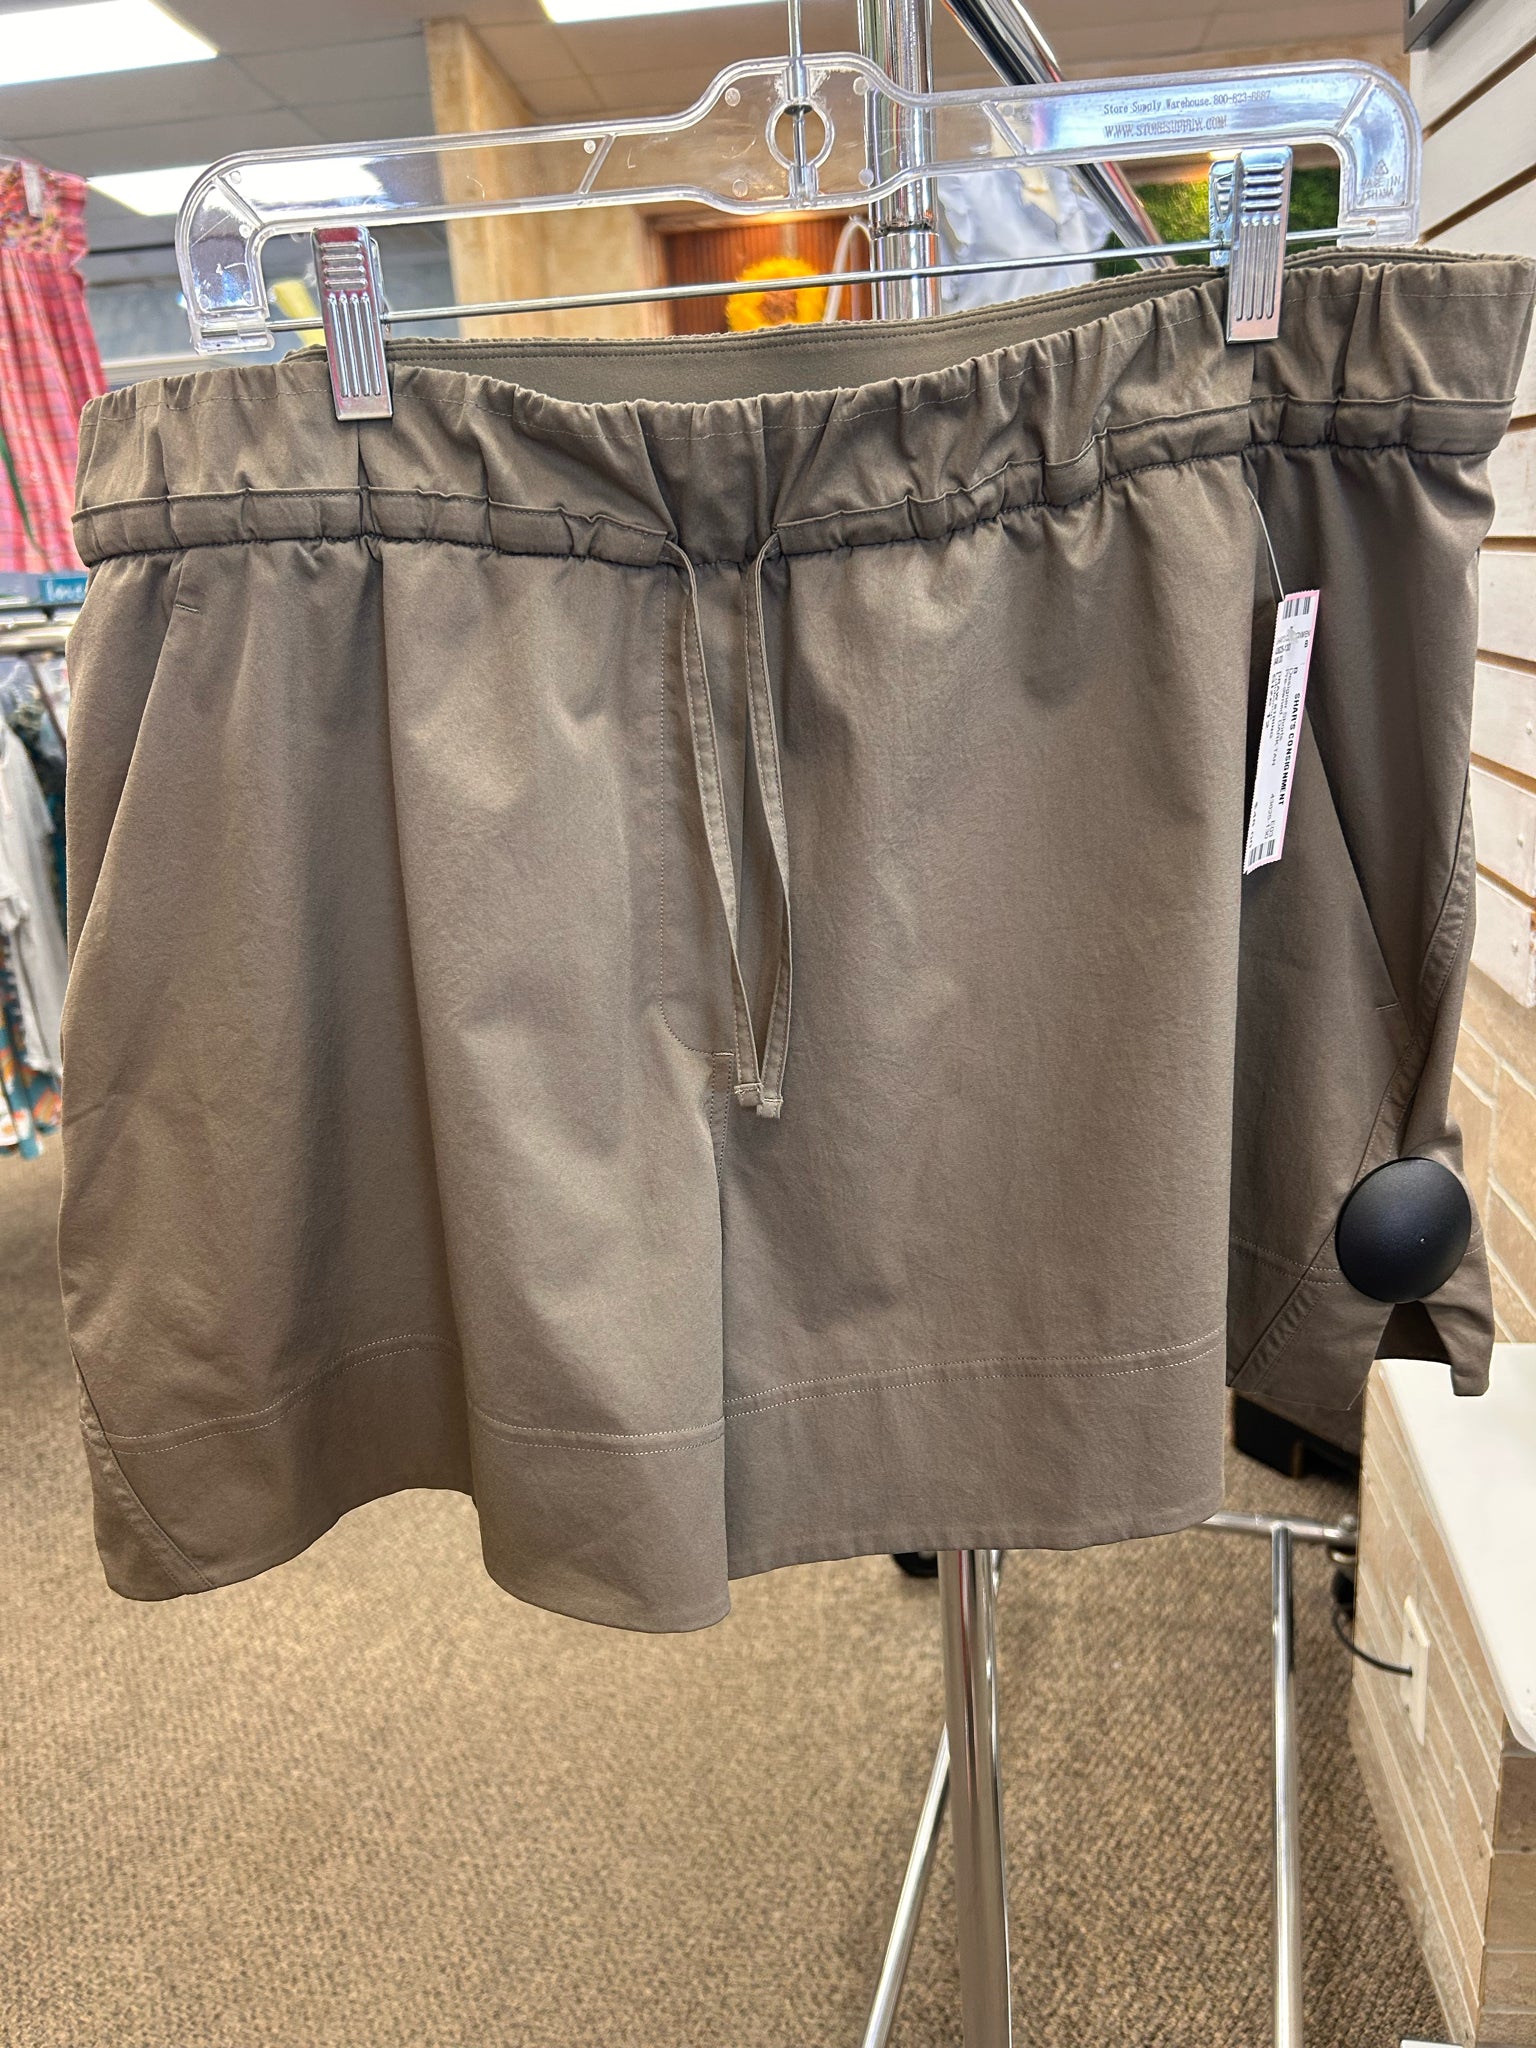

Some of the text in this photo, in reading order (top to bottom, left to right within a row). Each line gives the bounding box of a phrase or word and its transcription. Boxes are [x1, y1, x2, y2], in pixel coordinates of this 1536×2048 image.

[1104, 103, 1128, 115] Store
[1132, 100, 1162, 114] Supply
[1278, 692, 1301, 806] SHAR'S CONSIGNMENT
